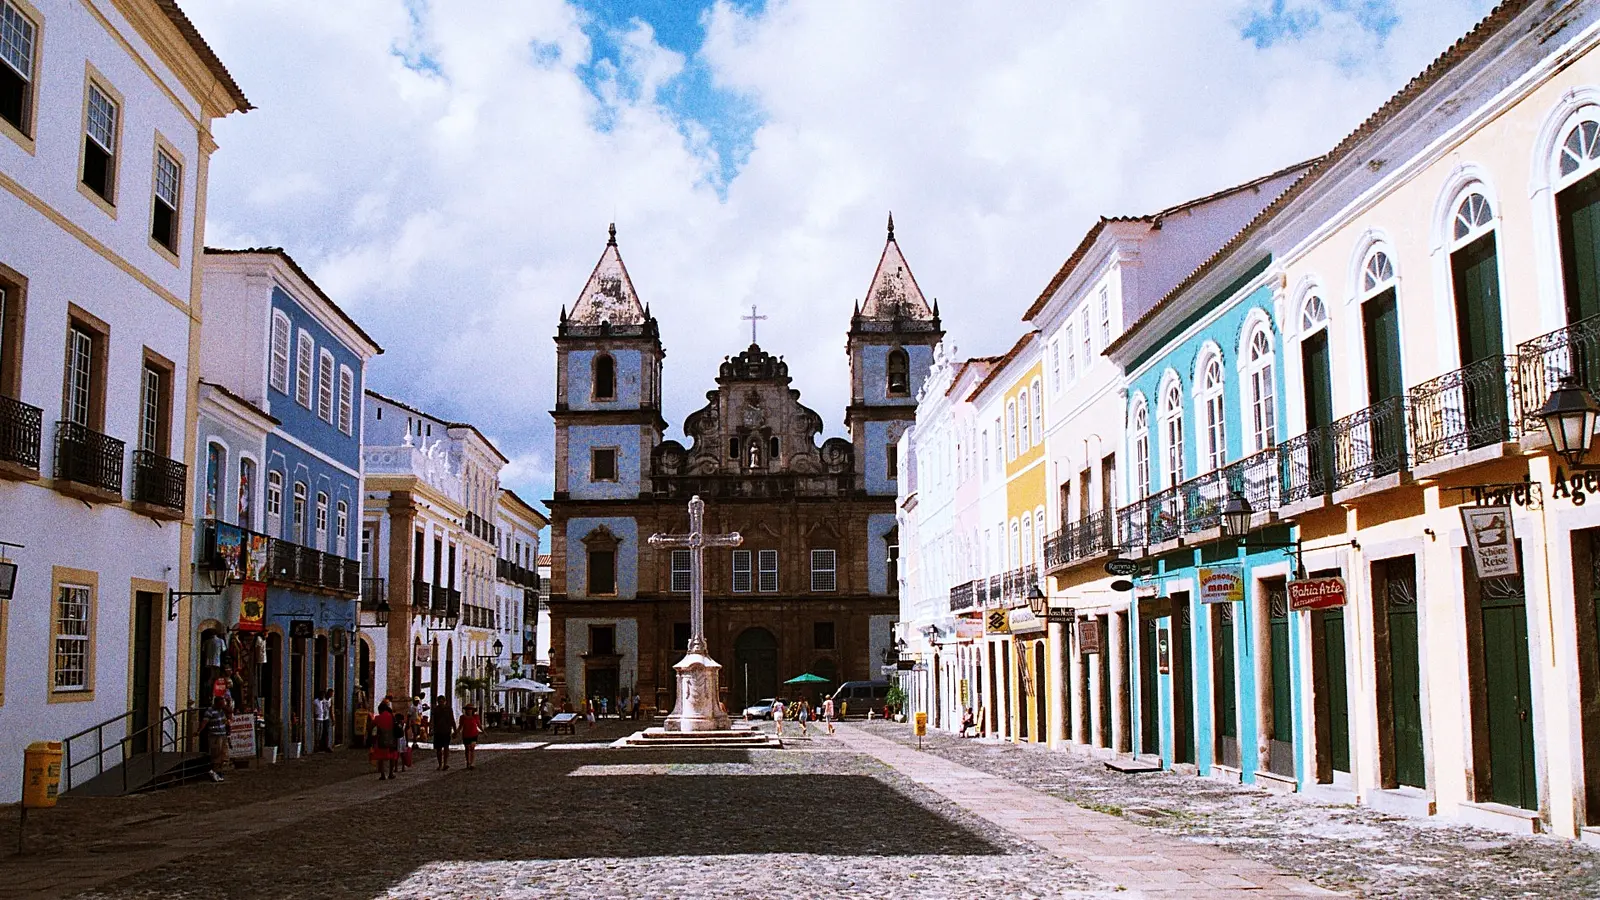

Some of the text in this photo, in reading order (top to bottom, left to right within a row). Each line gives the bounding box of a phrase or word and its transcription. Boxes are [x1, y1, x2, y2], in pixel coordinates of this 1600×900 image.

[1471, 466, 1600, 506] Travel Age
[1482, 556, 1508, 567] Reise
[1292, 581, 1343, 597] Bahia Arte
